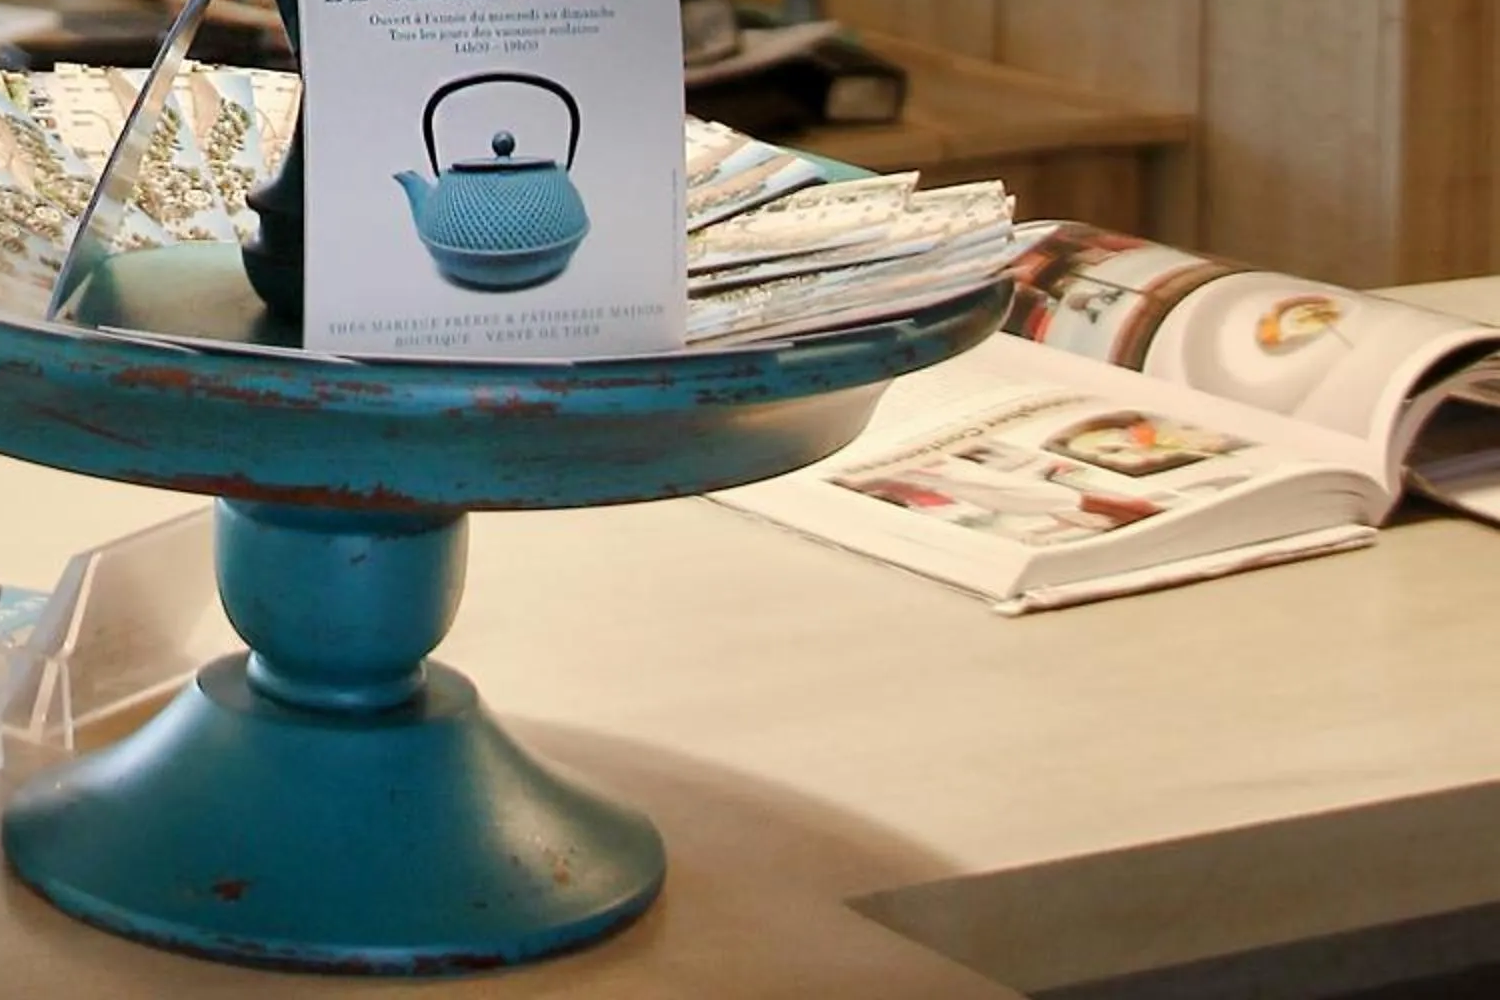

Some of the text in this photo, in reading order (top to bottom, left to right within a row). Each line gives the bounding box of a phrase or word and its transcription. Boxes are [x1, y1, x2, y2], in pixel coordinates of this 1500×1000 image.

[369, 12, 411, 25] Ouvert
[560, 5, 615, 20] dimanche
[389, 27, 417, 41] Tous
